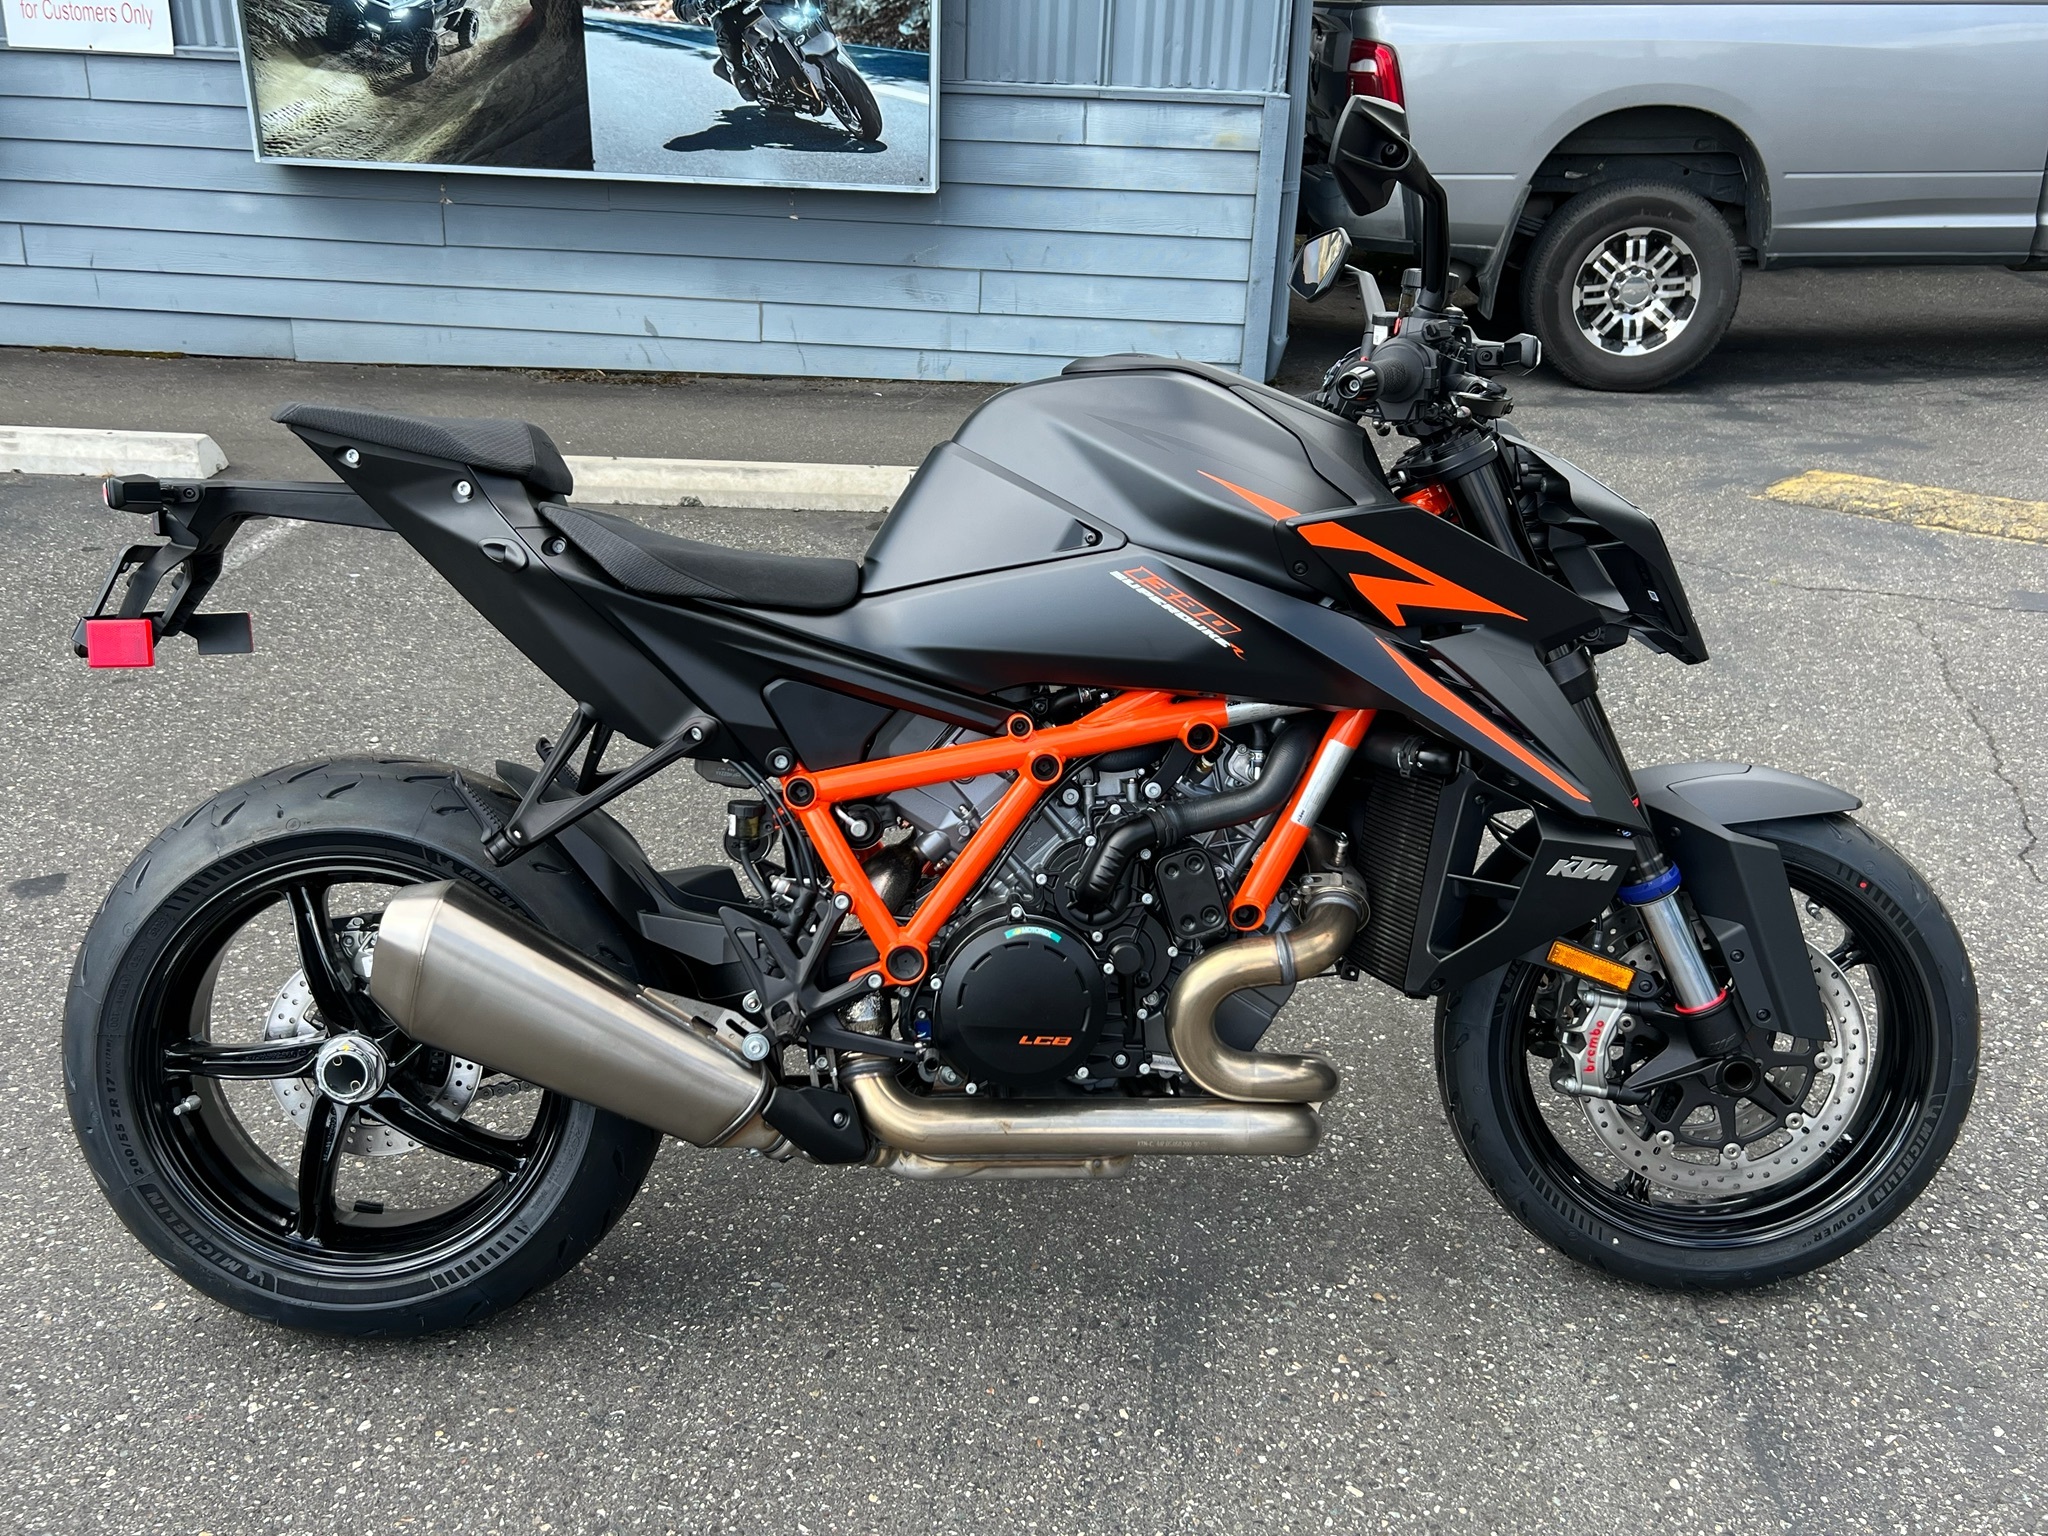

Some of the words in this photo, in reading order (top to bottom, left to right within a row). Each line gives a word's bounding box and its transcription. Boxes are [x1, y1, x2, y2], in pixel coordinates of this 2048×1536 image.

[20, 0, 37, 19] for
[42, 0, 118, 23] Customers
[121, 2, 153, 30] Only
[1123, 566, 1242, 635] 1390
[1546, 855, 1618, 881] KTM
[1019, 1035, 1072, 1046] LC8
[1583, 1020, 1605, 1072] brembo
[106, 1077, 116, 1092] 17
[109, 1098, 121, 1118] ZR
[115, 1123, 144, 1176] 200/55
[1873, 1121, 1934, 1202] MICHELIN
[146, 1191, 242, 1273] MICHELIN
[1814, 1205, 1866, 1242] POWER
